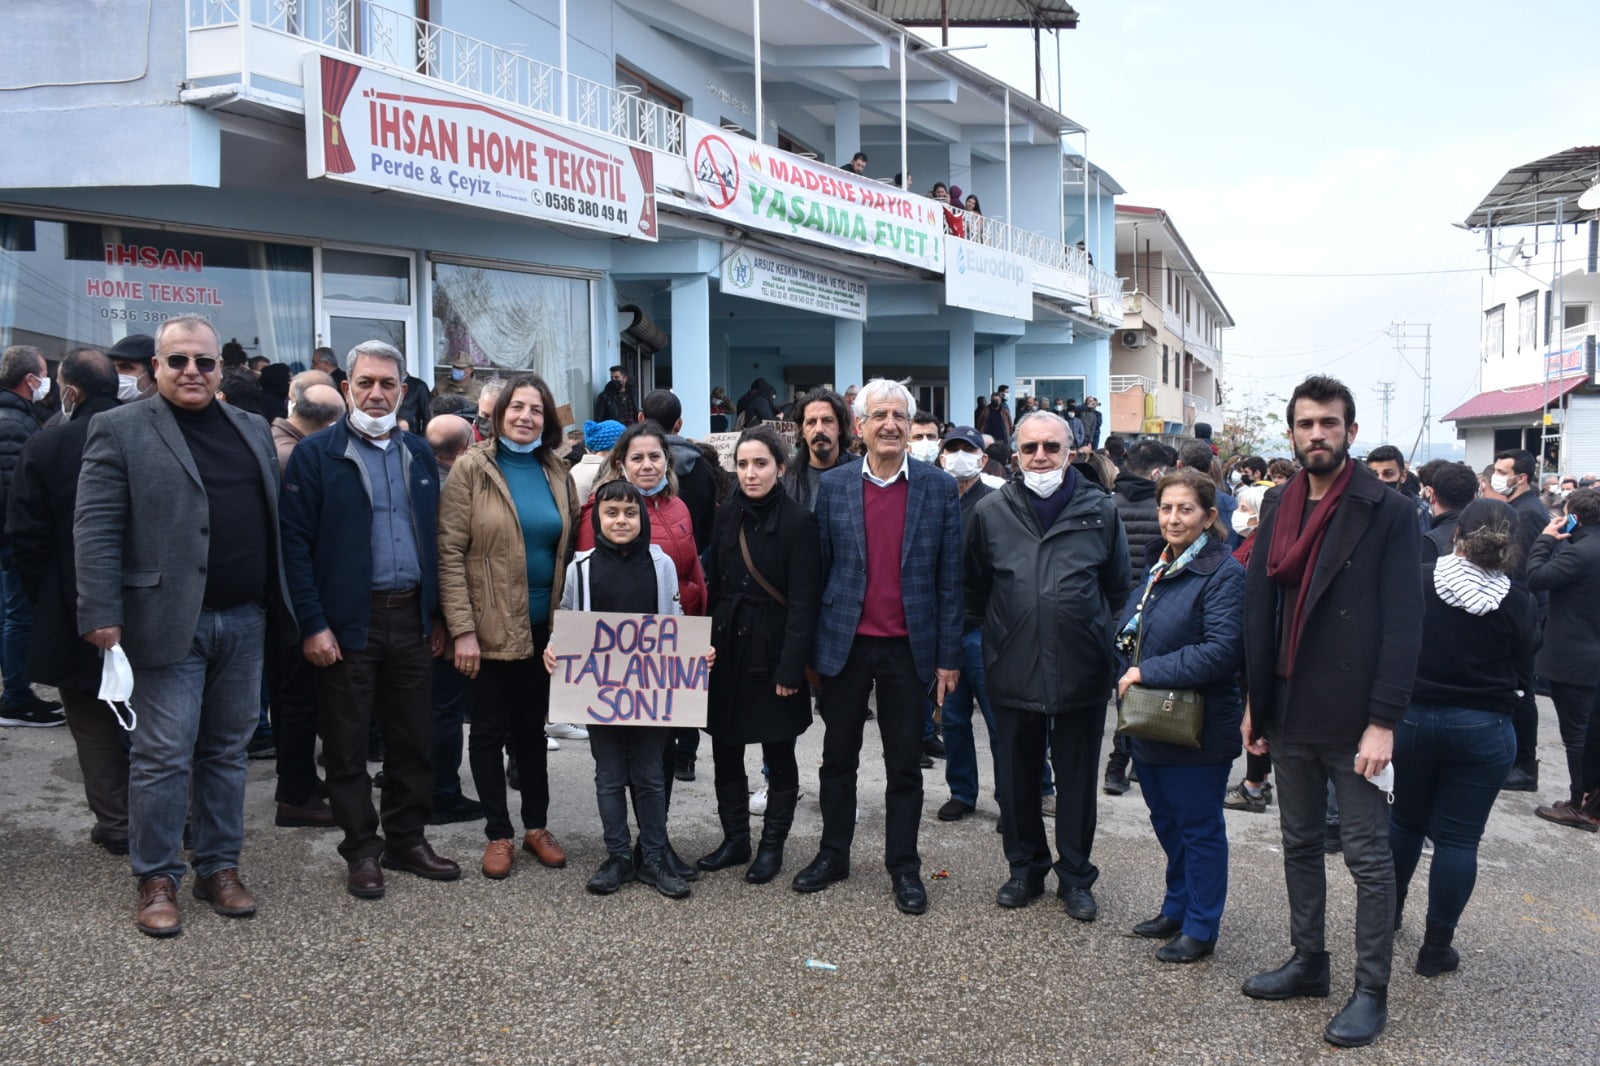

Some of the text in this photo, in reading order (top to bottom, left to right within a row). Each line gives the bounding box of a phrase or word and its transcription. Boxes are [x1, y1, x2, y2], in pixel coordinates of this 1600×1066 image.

[371, 153, 424, 181] Perde
[430, 166, 442, 185] &
[448, 170, 491, 196] Çeyiz
[467, 126, 538, 182] HOME
[543, 146, 626, 203] TEKSTİL
[545, 192, 575, 213] 0536
[577, 199, 599, 218] 380
[601, 205, 614, 221] 49
[617, 209, 627, 224] 41
[768, 157, 922, 223] MADENE HAYIR !
[748, 182, 939, 262] YAŞAMA EVET !
[753, 257, 775, 273] ARSUZ
[798, 268, 816, 283] TARIM
[966, 248, 1024, 287] Eurodrip
[87, 279, 143, 300] HOME
[100, 307, 137, 321] 0536
[143, 311, 168, 322] 380
[592, 615, 677, 654] DOĞA
[555, 652, 709, 691] TALANINA
[587, 686, 673, 722] SON!
